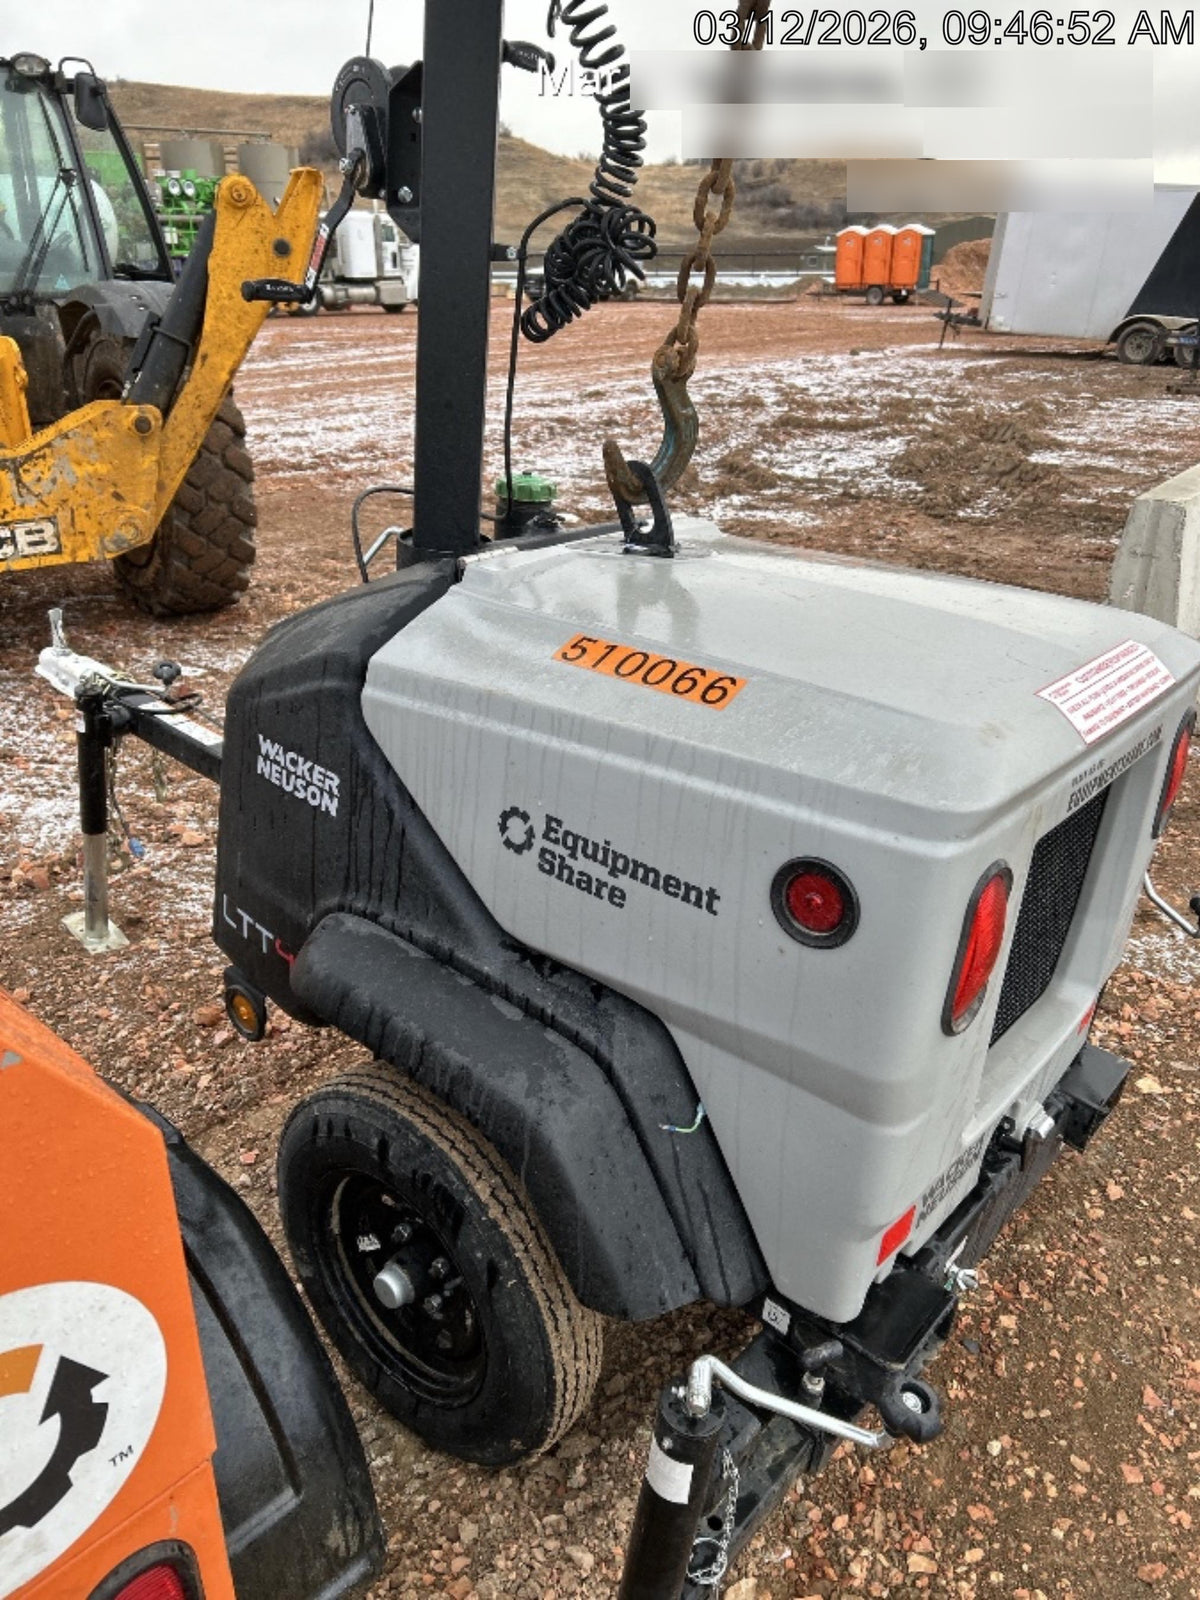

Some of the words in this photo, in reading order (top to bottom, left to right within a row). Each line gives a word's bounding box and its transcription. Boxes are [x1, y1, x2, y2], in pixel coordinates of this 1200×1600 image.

[561, 636, 737, 705] 510066
[257, 754, 338, 817] NEUSON
[258, 733, 340, 797] WACKER
[537, 846, 627, 909] Share
[541, 813, 721, 916] Equipment
[108, 1444, 134, 1467] TM
